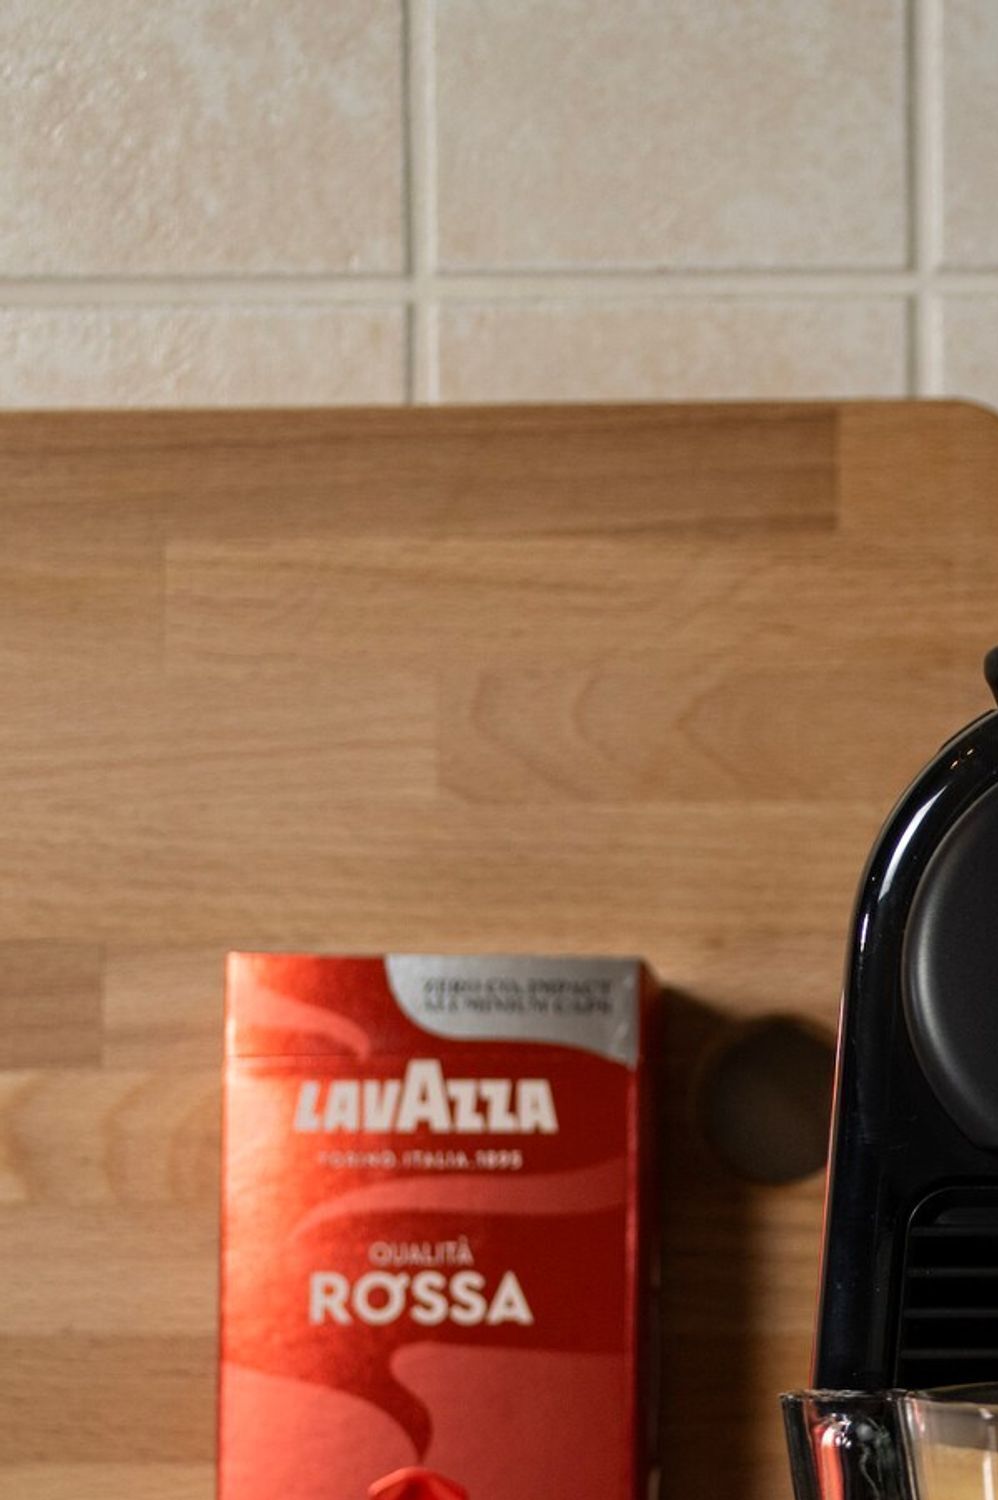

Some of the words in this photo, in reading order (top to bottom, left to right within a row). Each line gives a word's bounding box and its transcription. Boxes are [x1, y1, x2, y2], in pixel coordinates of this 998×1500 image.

[292, 1057, 559, 1134] LAVAZZA
[368, 1236, 474, 1266] QUALITÀ
[308, 1270, 534, 1326] ROSSA
